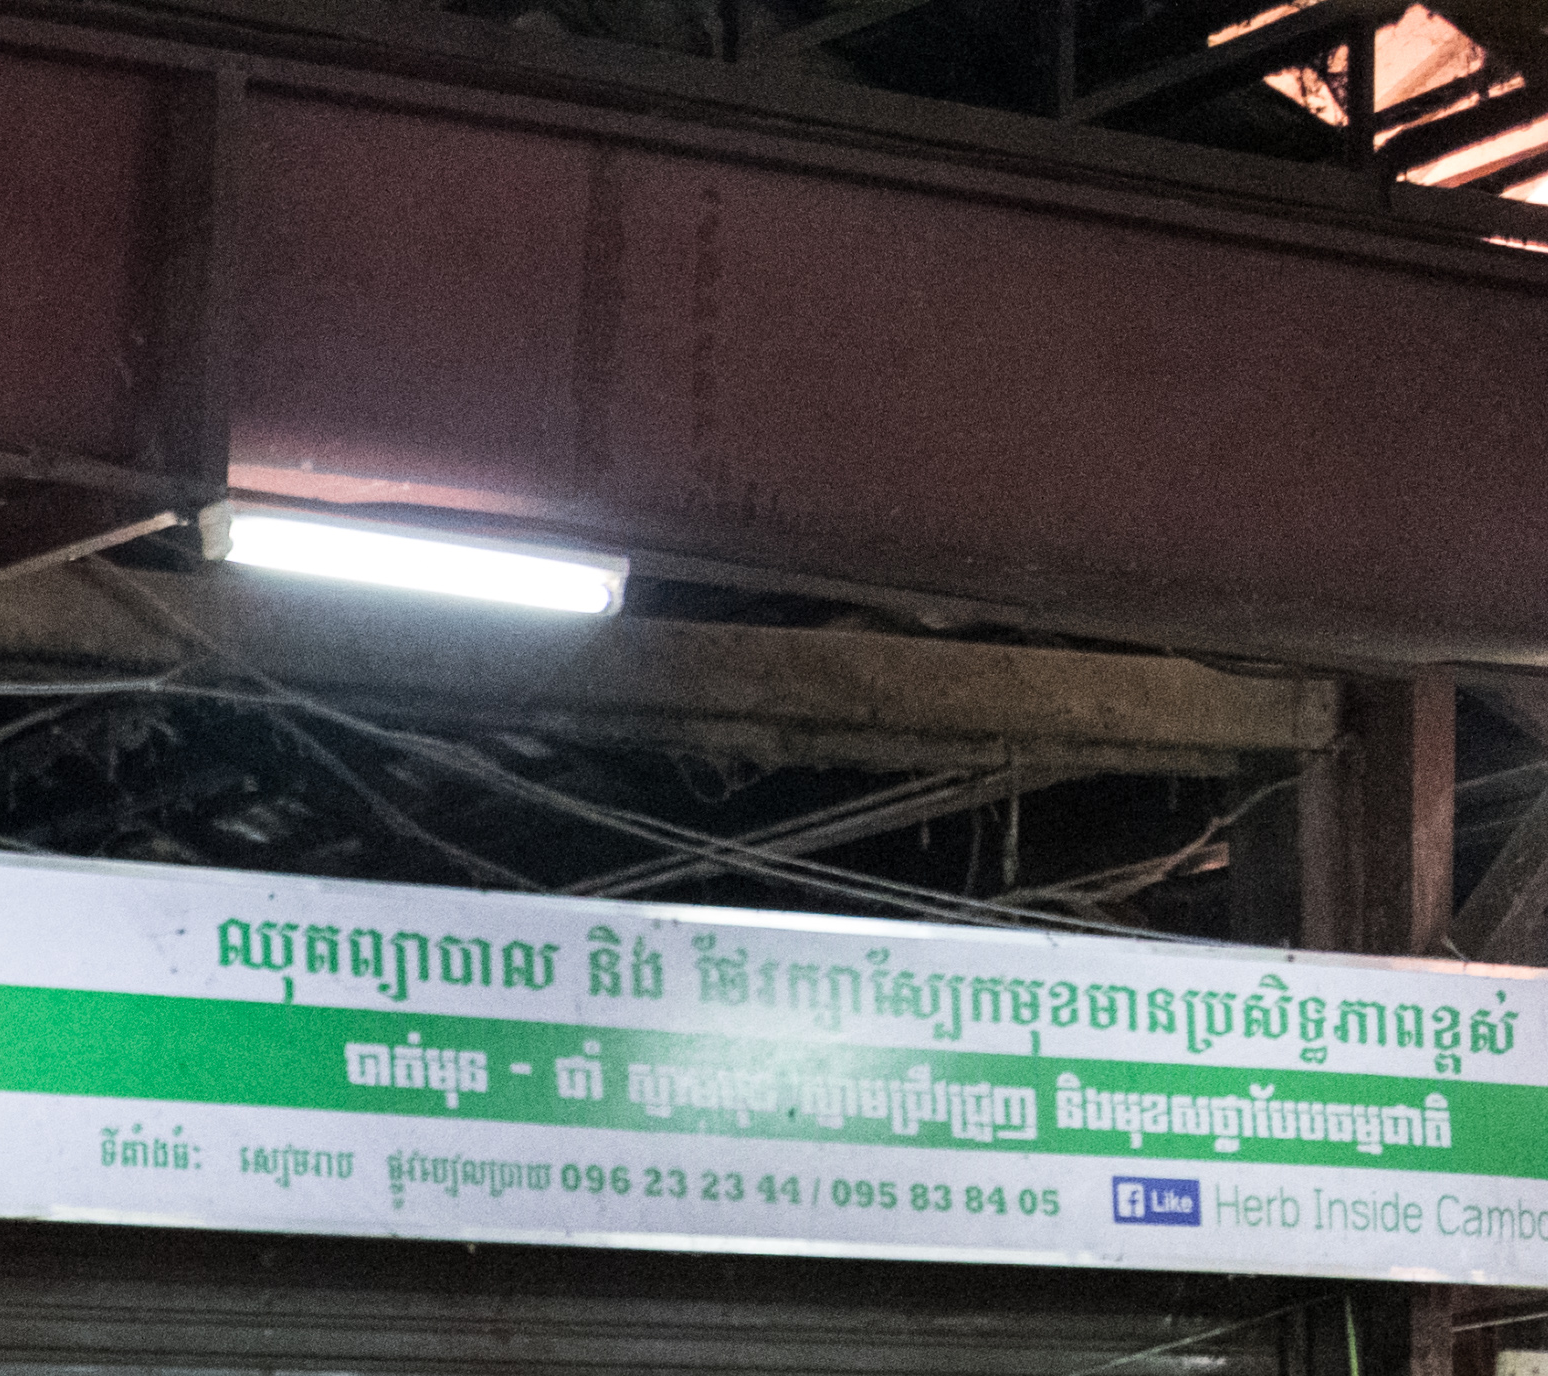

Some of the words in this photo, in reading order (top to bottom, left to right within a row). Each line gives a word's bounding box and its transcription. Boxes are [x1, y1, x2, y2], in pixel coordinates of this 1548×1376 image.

[586, 925, 664, 999] និង
[560, 1162, 632, 1197] 096
[642, 1166, 689, 1200] 23
[700, 1170, 746, 1202] 23
[830, 1177, 899, 1210] 095
[909, 1181, 953, 1213] 83
[964, 1185, 1009, 1215] 84
[1017, 1187, 1061, 1217] 05
[1151, 1189, 1194, 1215] Like
[1214, 1183, 1301, 1229] Herb
[1313, 1188, 1424, 1234] Inside
